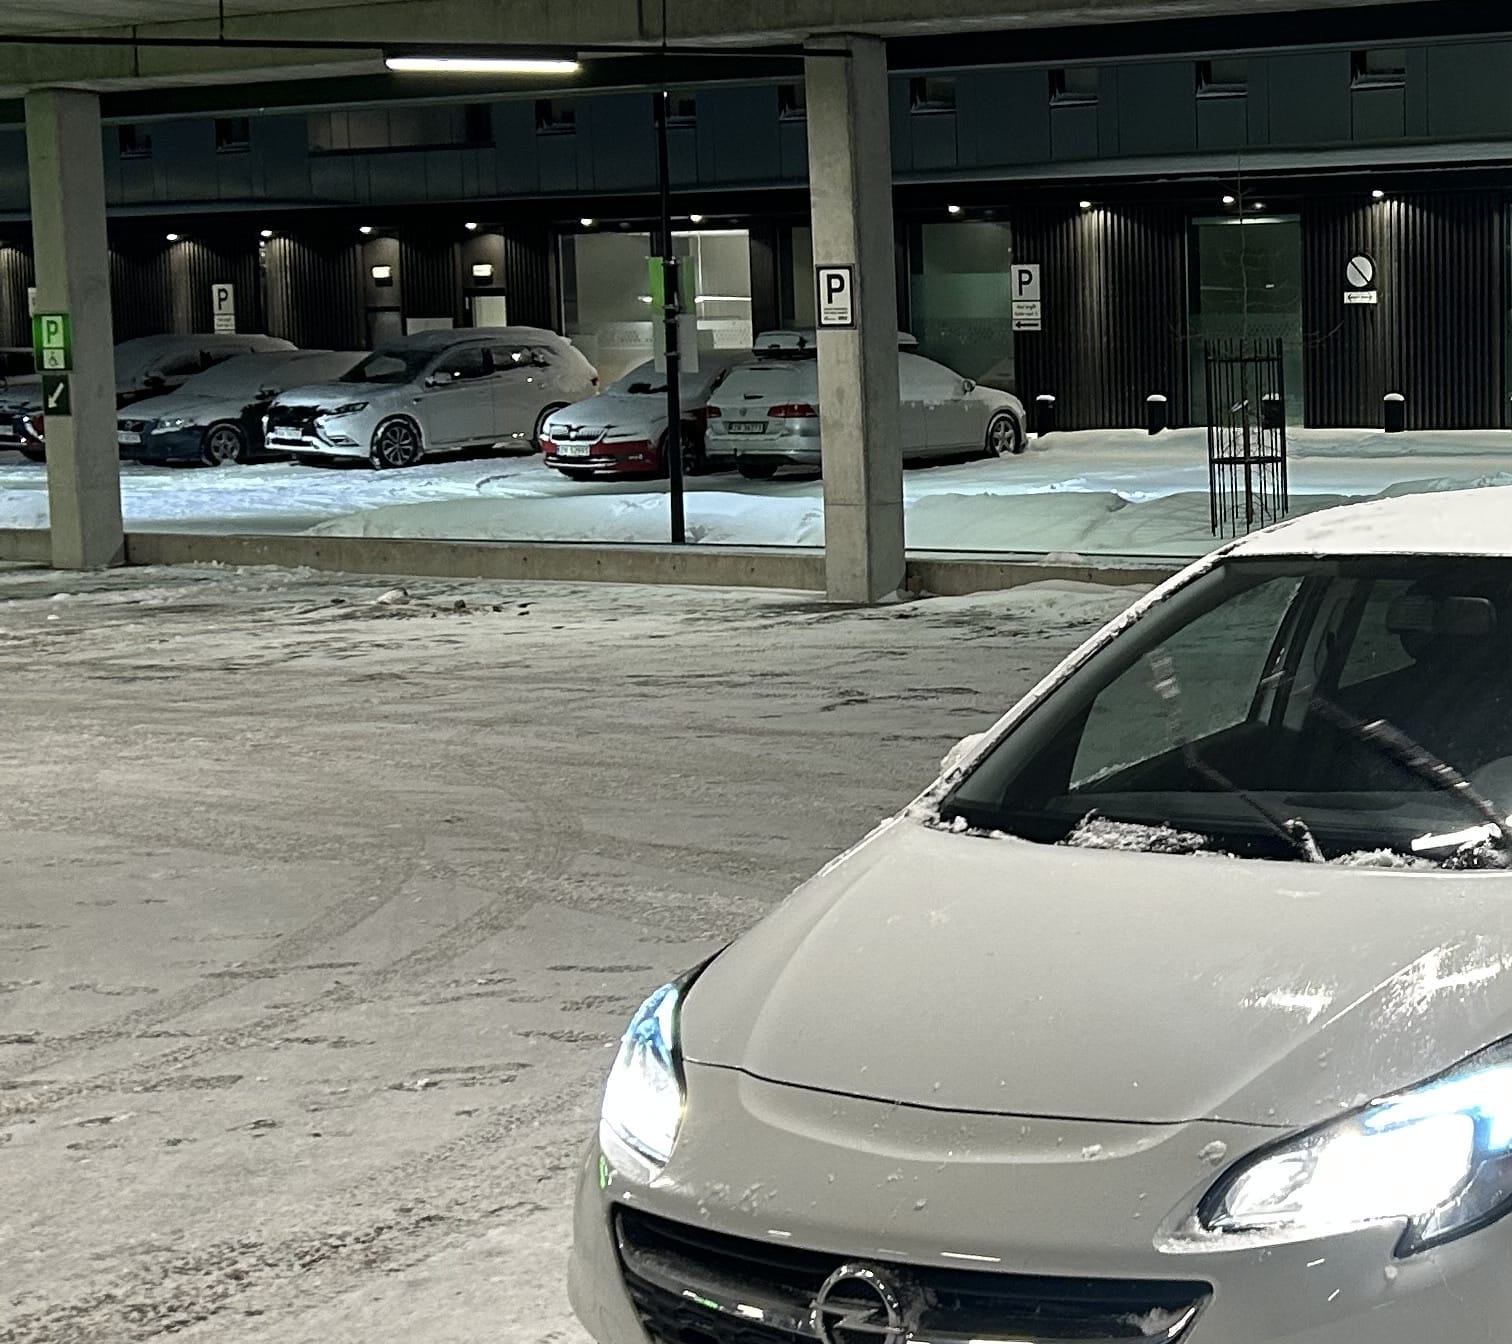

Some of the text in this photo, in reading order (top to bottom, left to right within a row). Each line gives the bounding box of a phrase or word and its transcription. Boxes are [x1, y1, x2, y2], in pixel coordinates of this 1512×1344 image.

[827, 273, 845, 304] P
[1018, 269, 1033, 297] P
[217, 288, 229, 311] P
[46, 320, 58, 344] P
